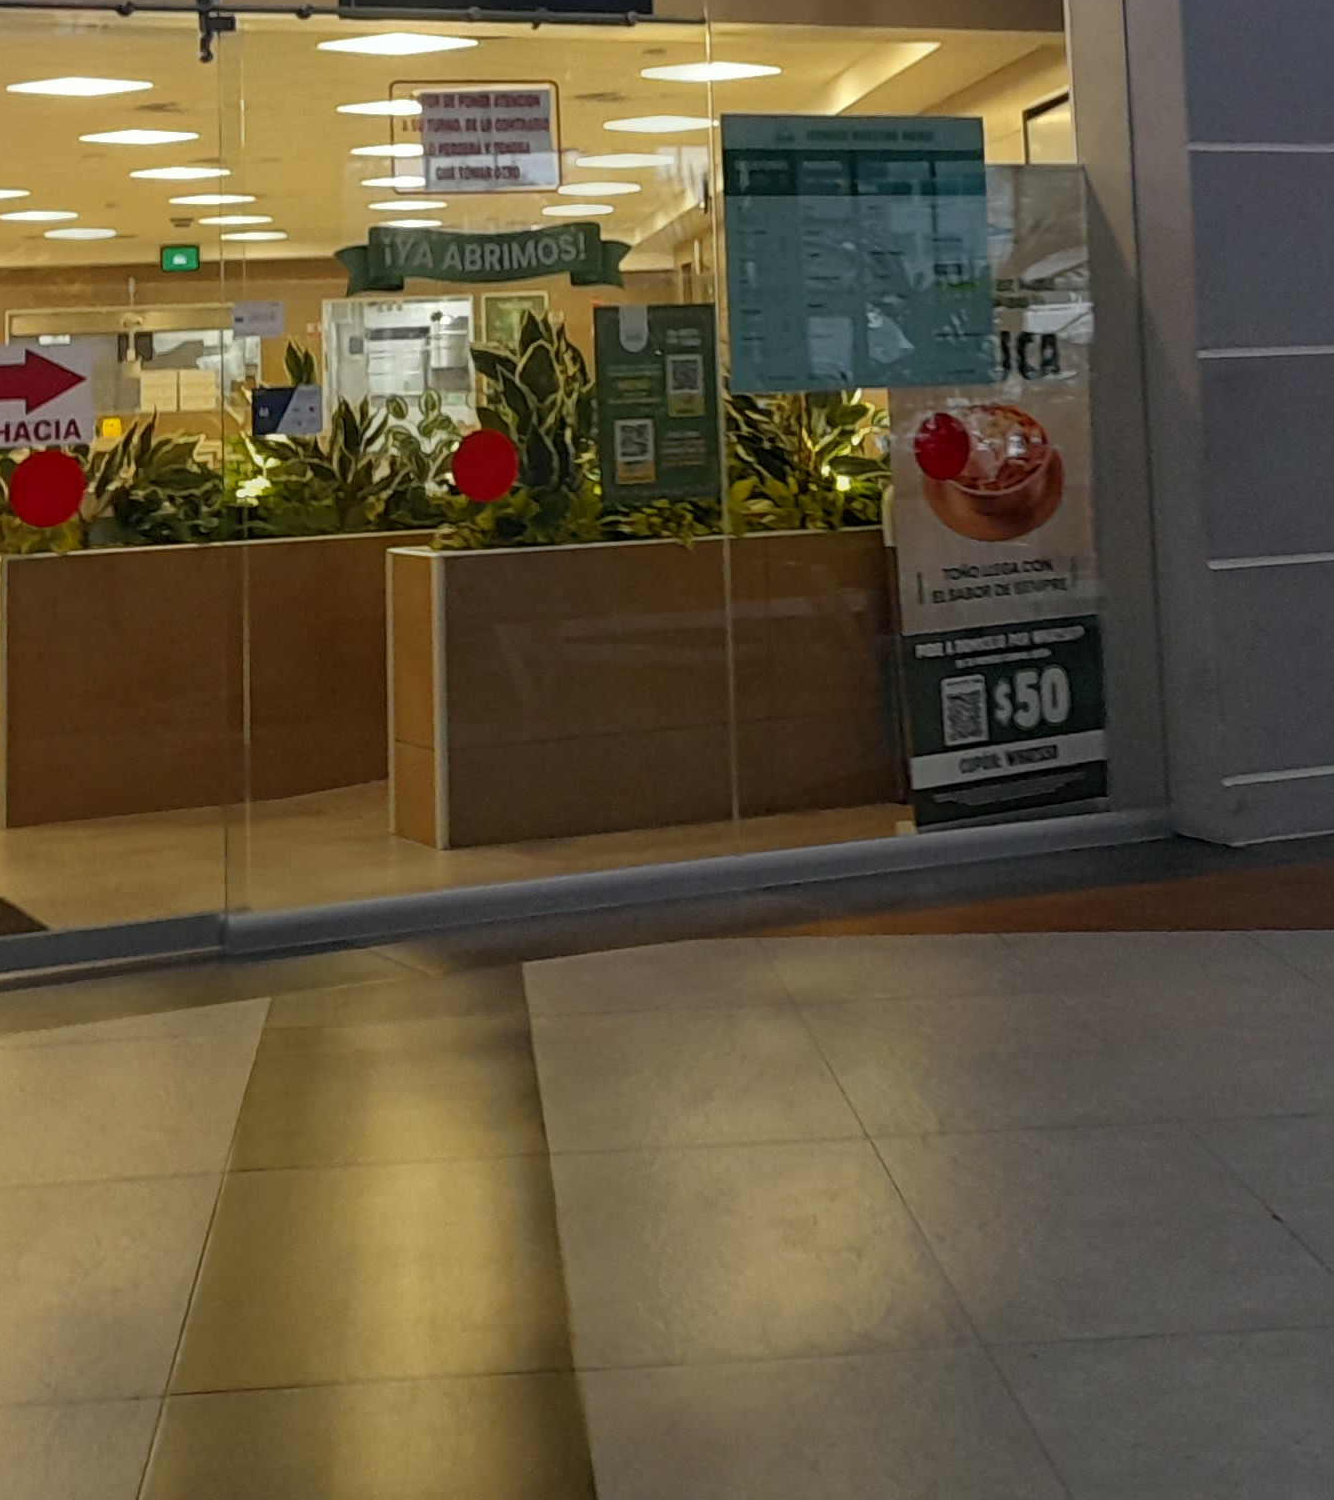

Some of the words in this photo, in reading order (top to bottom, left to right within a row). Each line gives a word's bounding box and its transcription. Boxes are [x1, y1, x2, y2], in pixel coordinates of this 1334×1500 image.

[383, 237, 435, 271] ¡YA
[442, 232, 586, 274] ABRIMOS!
[994, 667, 1071, 728] $50
